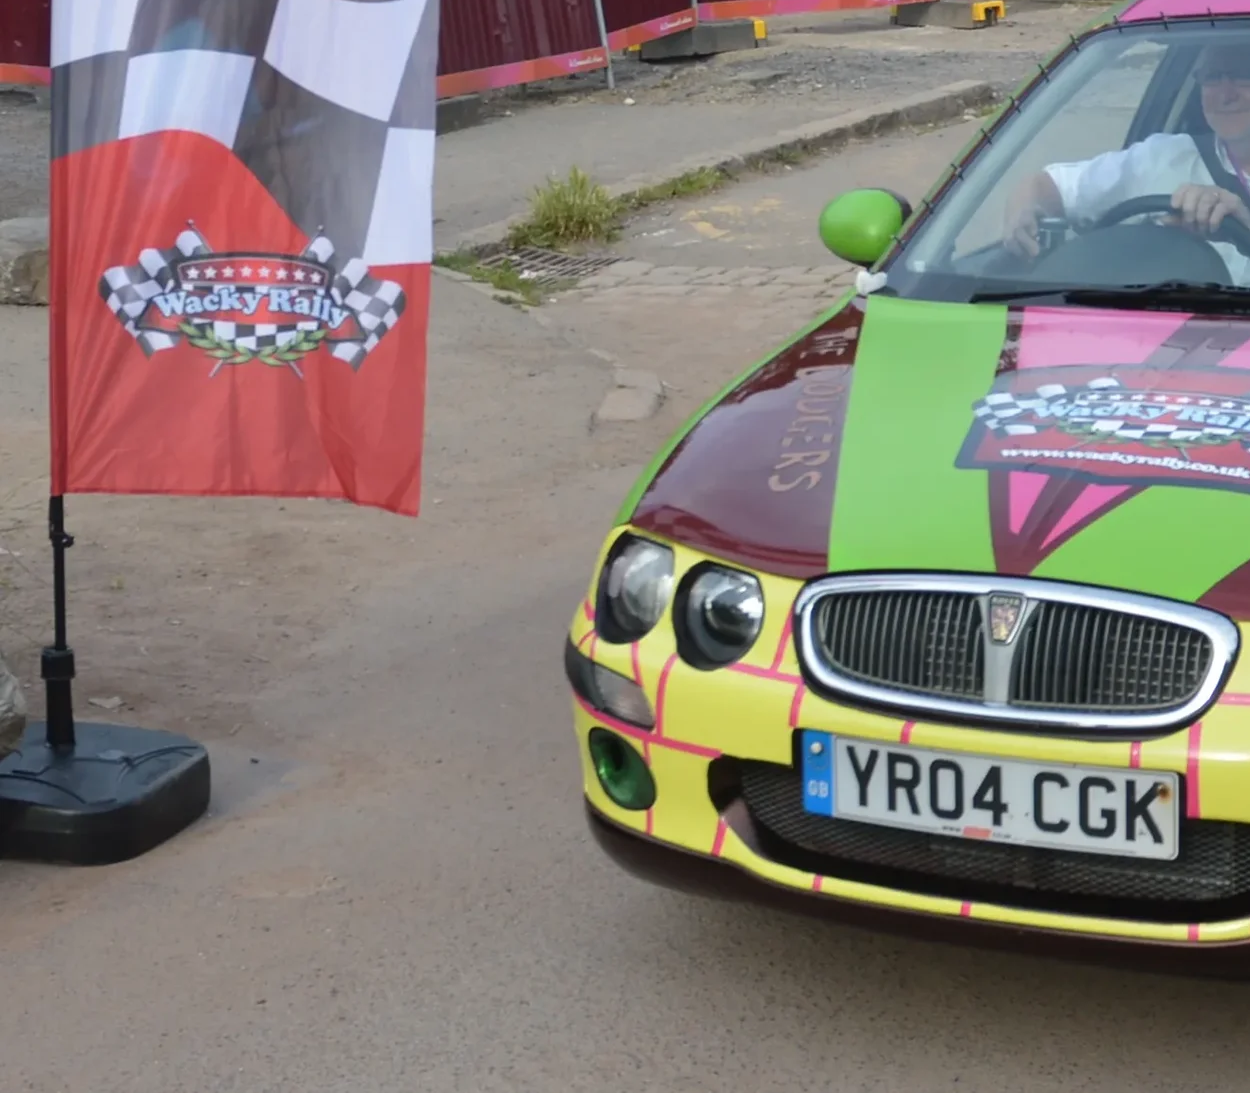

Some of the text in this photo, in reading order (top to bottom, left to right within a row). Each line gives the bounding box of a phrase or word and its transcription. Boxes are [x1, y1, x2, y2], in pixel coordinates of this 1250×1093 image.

[152, 287, 351, 329] Wacky Rally
[1033, 398, 1171, 421] Wacky
[999, 448, 1250, 480] www.wackyrally.co.uk
[807, 779, 829, 798] GB
[846, 745, 1167, 845] YR04 CGK
